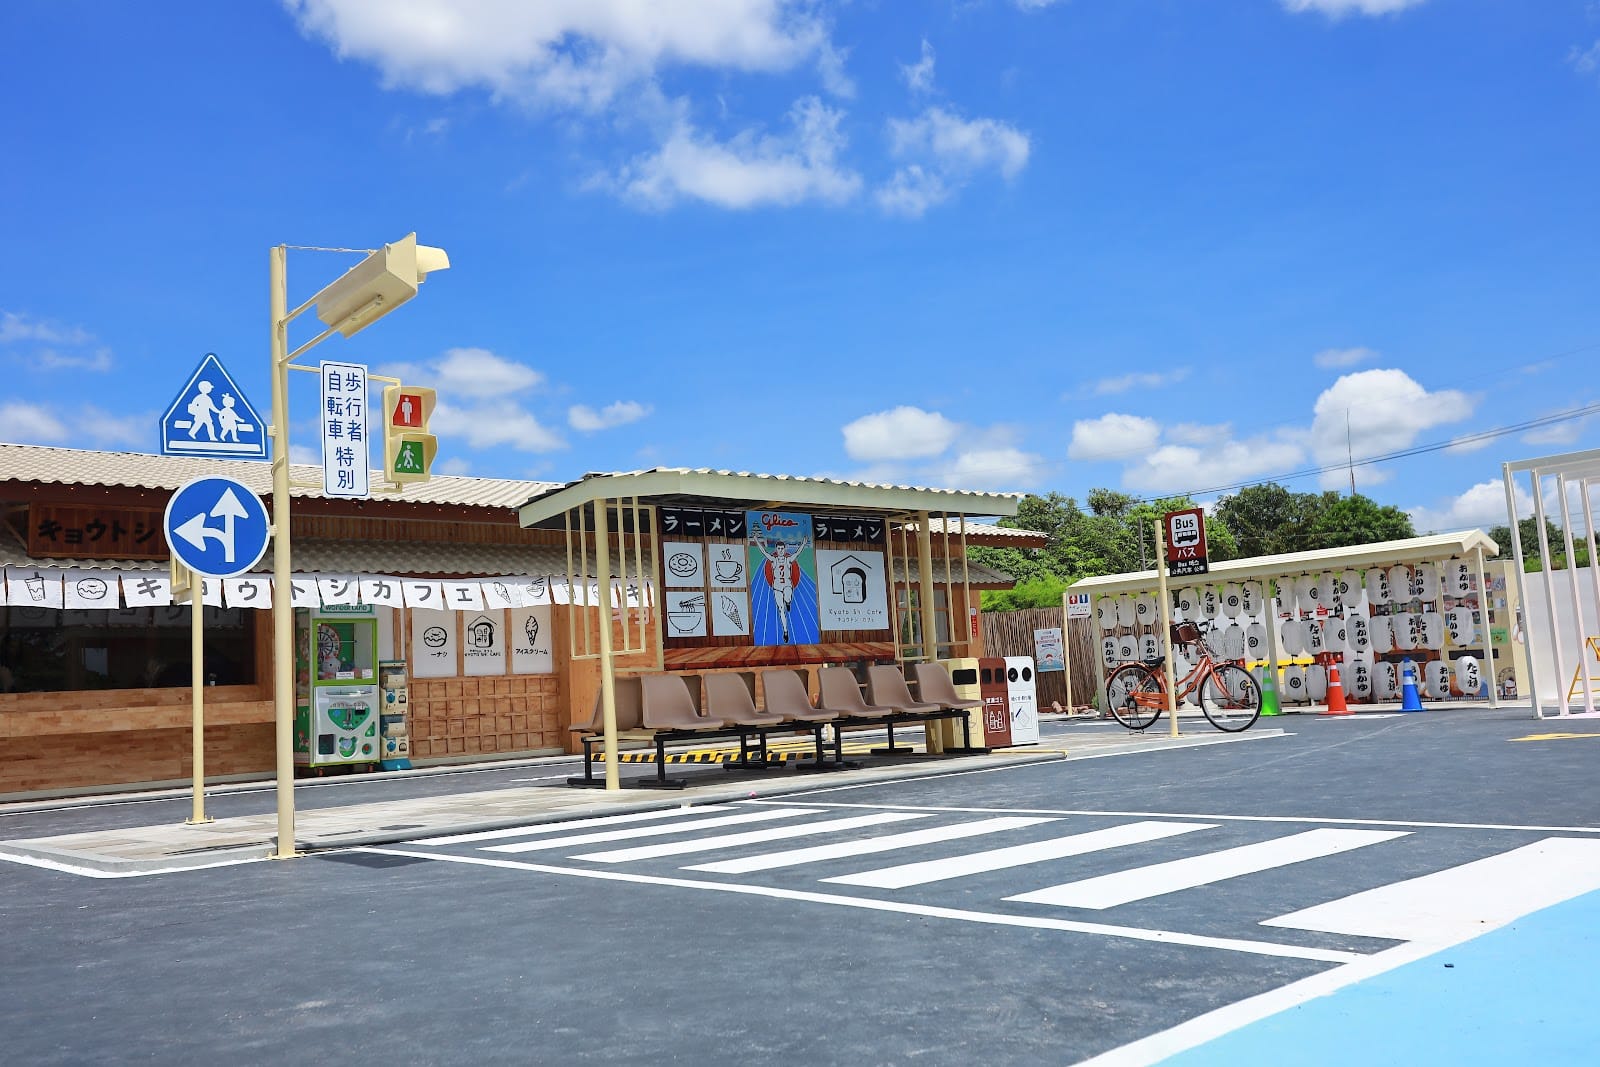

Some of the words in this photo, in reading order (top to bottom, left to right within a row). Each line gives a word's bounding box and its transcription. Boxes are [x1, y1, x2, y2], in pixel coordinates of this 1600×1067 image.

[327, 370, 344, 440] 自転車
[345, 372, 362, 442] 歩行者
[336, 446, 355, 490] 特別
[38, 517, 156, 544] キョウトシ
[663, 514, 743, 534] ラーメン
[815, 523, 881, 540] ラーメン
[1175, 518, 1194, 529] Bus
[1177, 547, 1197, 558] バス
[1459, 564, 1469, 591] おかゆ
[1355, 620, 1368, 646] おかゆ
[1355, 666, 1368, 692] おかゆ
[1439, 666, 1449, 693] おかゆ
